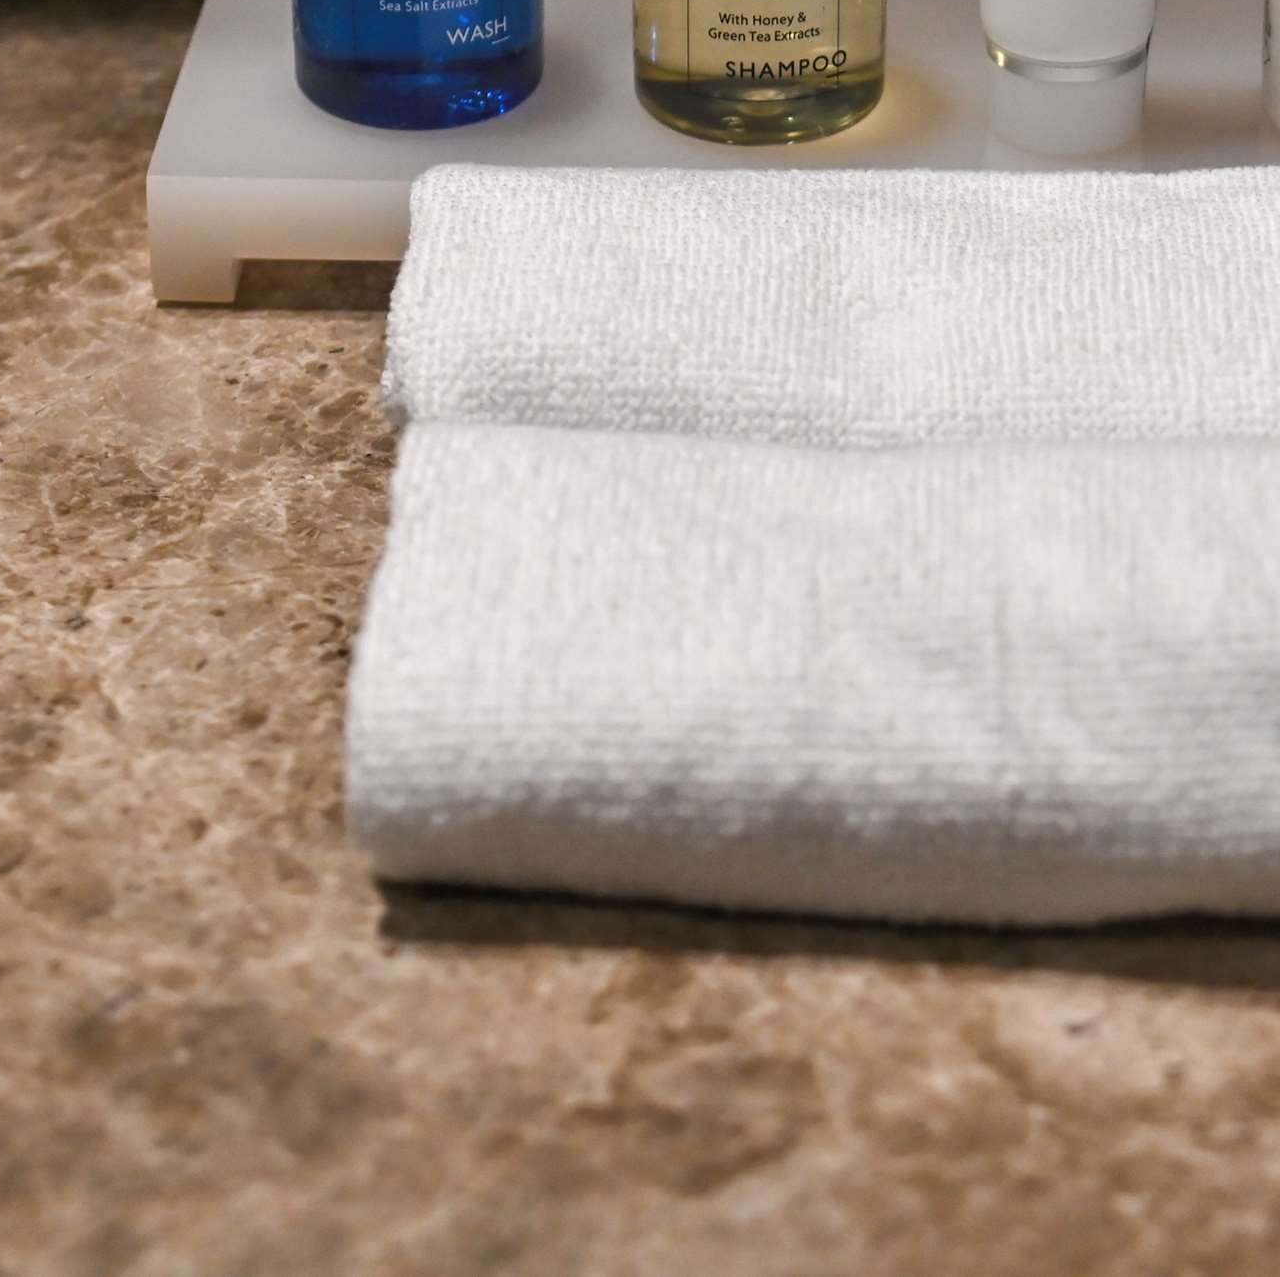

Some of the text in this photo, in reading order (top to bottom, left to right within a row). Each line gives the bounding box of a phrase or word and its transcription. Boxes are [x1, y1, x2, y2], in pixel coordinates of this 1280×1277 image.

[379, 0, 402, 12] Sea
[405, 0, 429, 12] Salt
[718, 11, 807, 27] With Honey &
[446, 15, 508, 45] WASH
[708, 26, 821, 42] Green Tea Extracts
[725, 49, 848, 79] SHAMPOO
